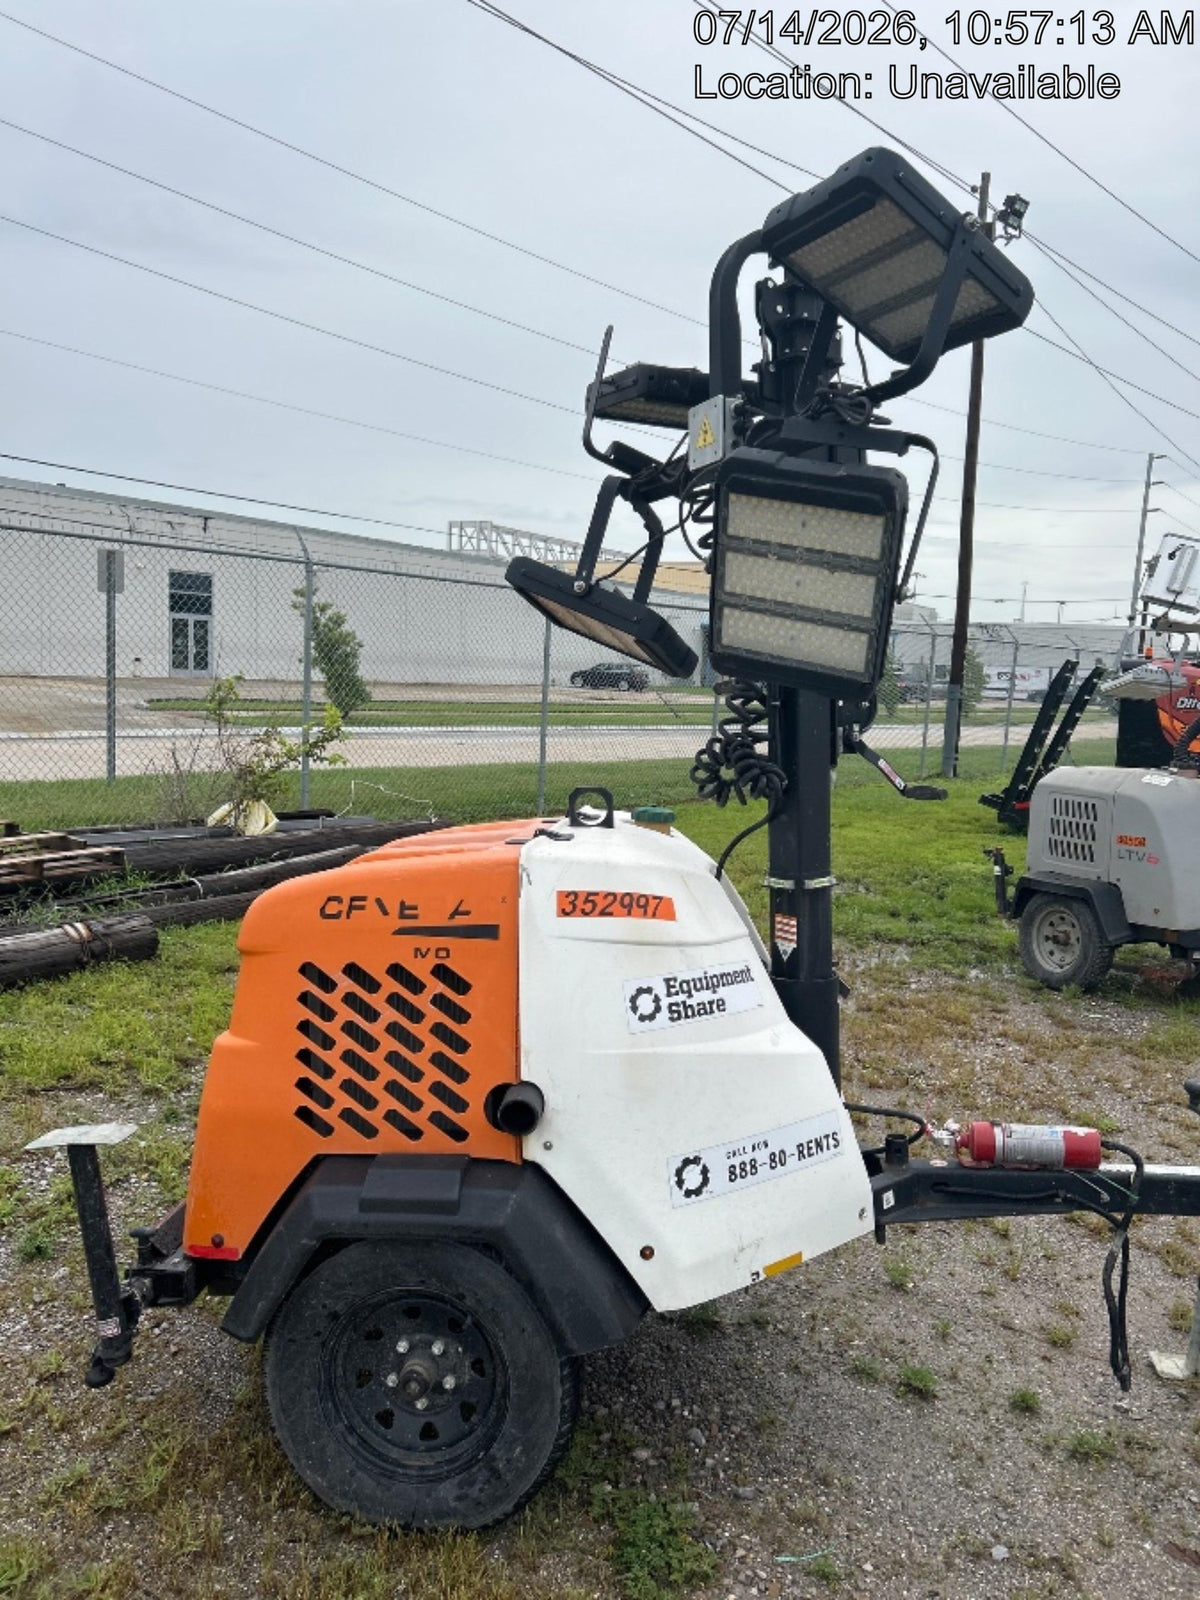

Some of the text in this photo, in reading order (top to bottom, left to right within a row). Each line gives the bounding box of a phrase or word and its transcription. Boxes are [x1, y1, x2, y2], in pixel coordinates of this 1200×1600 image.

[560, 890, 664, 919] 352997
[663, 964, 755, 999] Equipment
[667, 996, 727, 1023] Share
[728, 1131, 840, 1182] 888-80-RENTS
